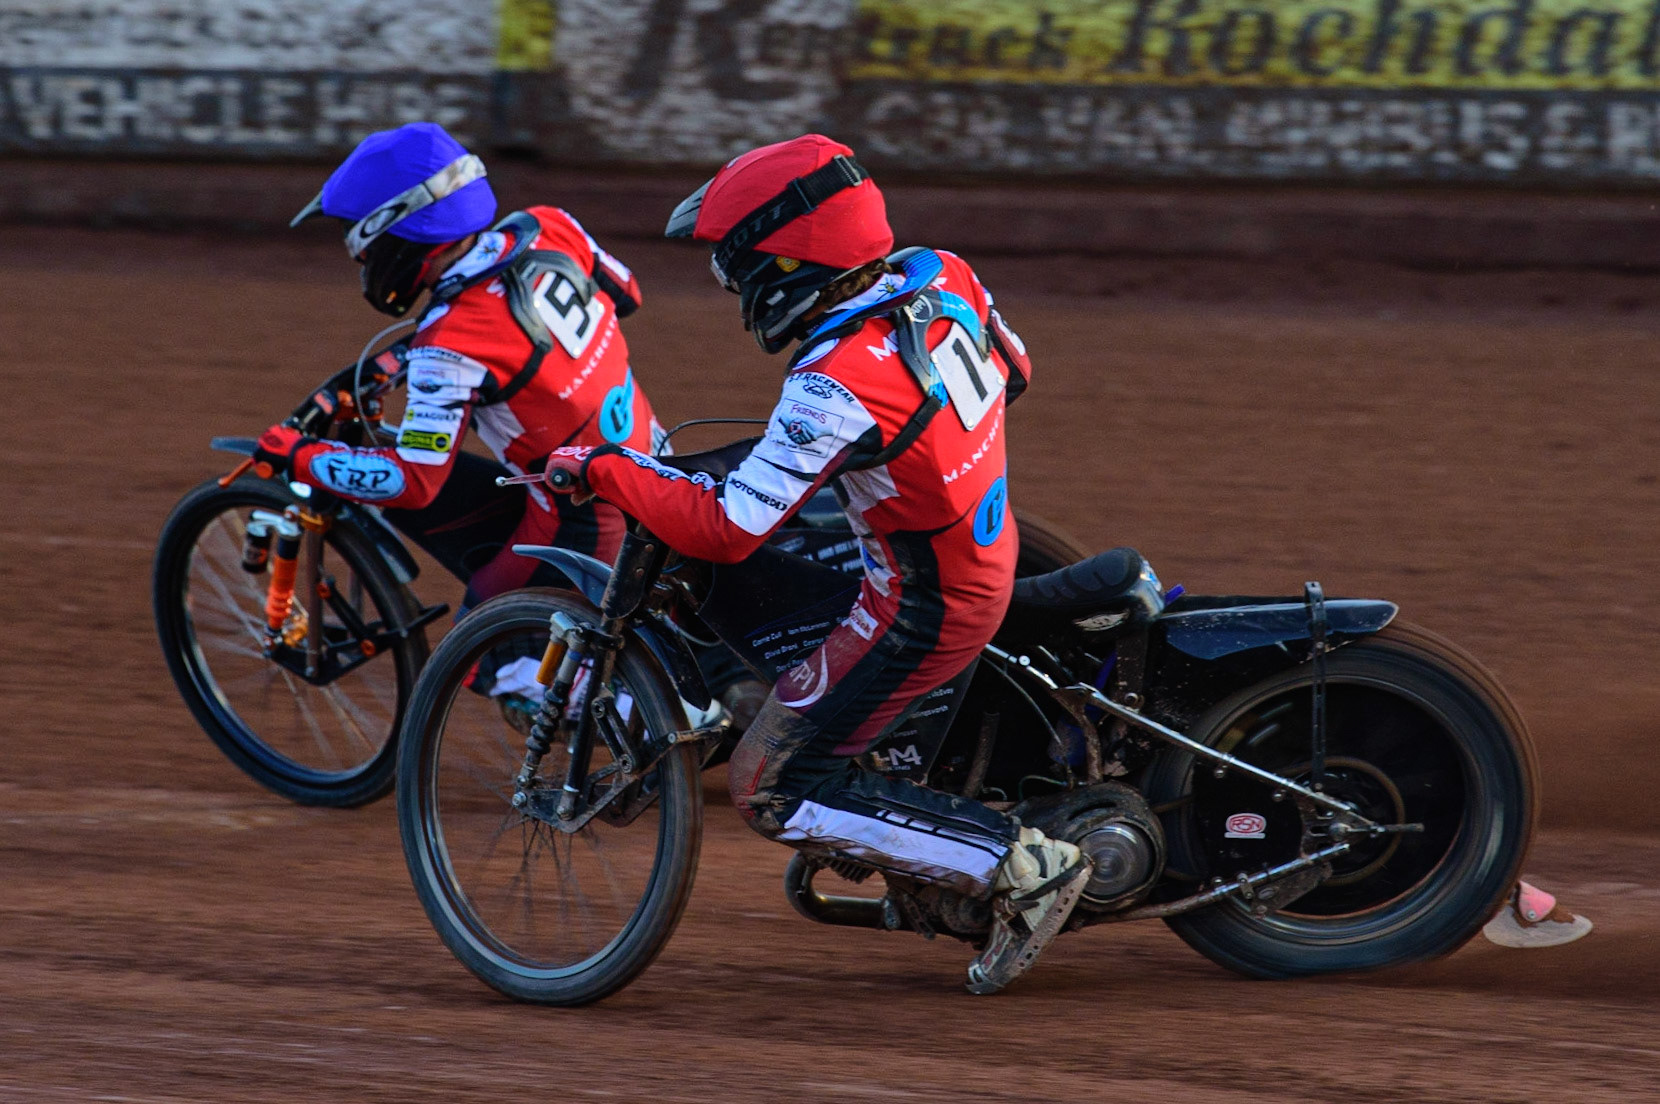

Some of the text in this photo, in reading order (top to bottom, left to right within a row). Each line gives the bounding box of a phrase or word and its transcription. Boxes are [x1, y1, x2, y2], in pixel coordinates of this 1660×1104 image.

[543, 271, 591, 339] 5
[952, 337, 989, 403] 1
[327, 458, 391, 489] FRP
